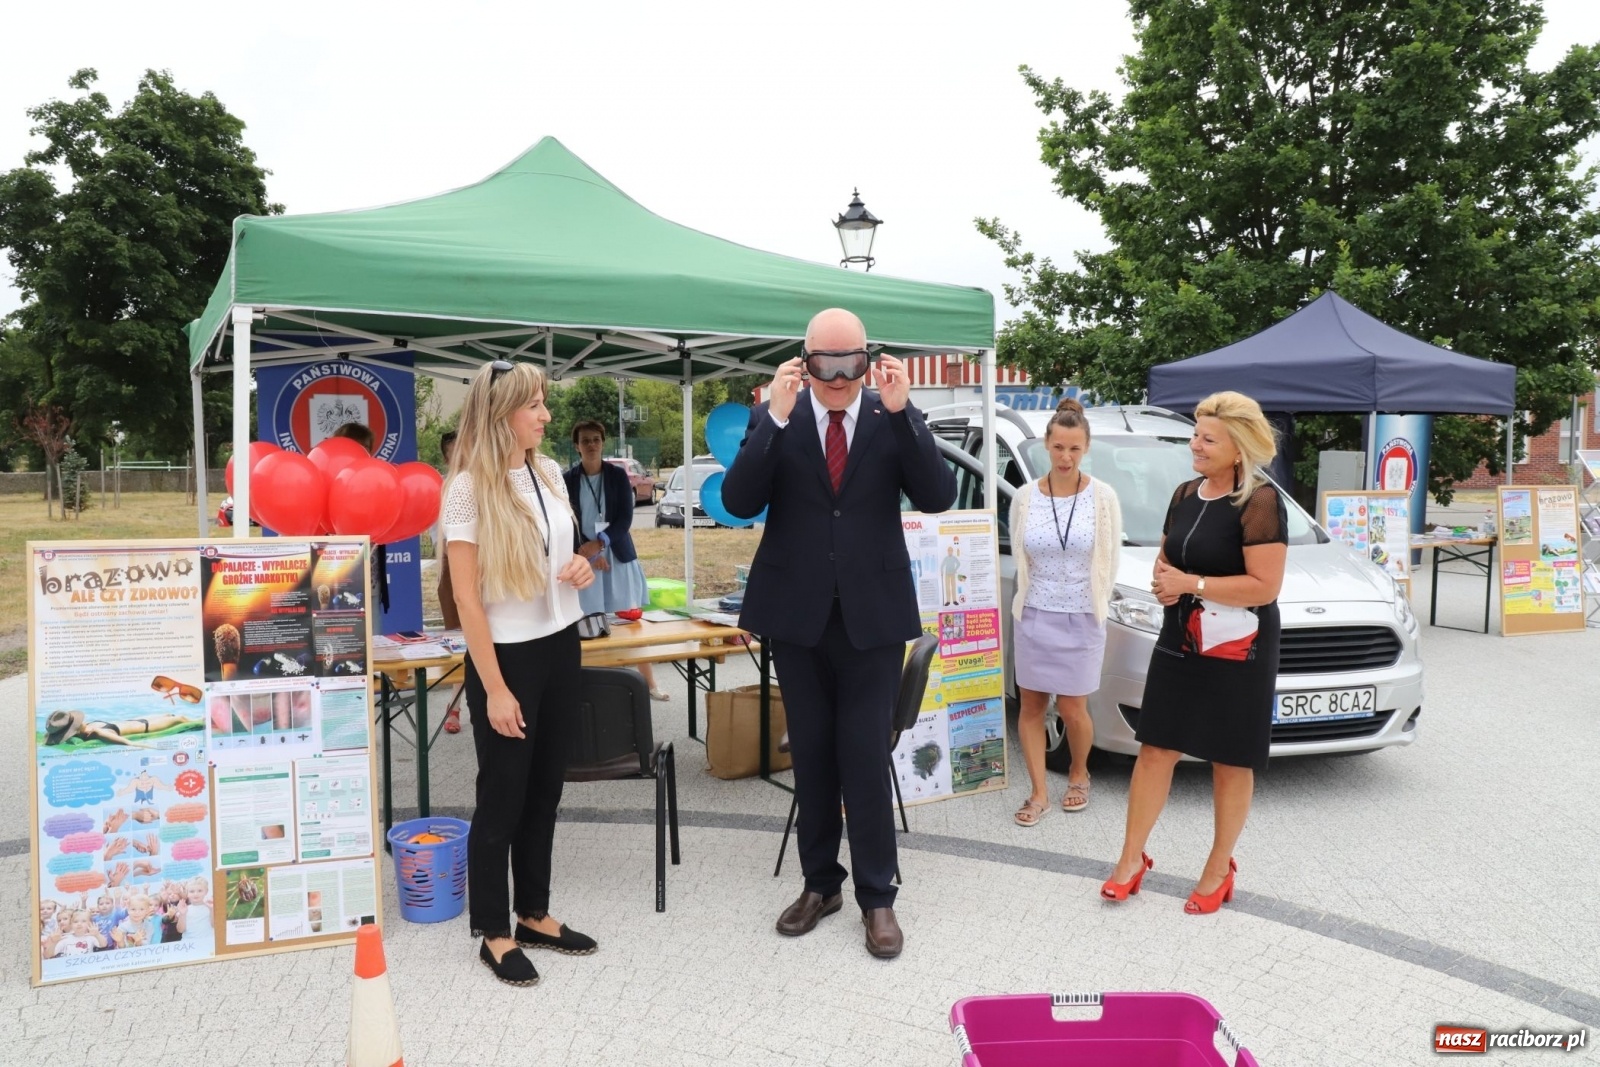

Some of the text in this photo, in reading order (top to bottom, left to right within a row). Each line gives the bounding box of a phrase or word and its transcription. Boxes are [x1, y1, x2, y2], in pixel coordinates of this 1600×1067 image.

[292, 363, 381, 391] PAŃSTWOWA
[39, 558, 194, 595] brązowo
[211, 561, 256, 573] DOPALACZE
[262, 559, 308, 571] WYPALACZE
[222, 572, 299, 585] GROŹNE NARKOTYKI
[70, 586, 199, 603] ALE CZY ZDROWO?
[949, 703, 987, 721] BEZPIECZNE
[1281, 695, 1322, 717] SRC
[1328, 690, 1372, 713] 8CA2
[65, 942, 196, 968] SZKOŁA CZYSTYCH RĄK
